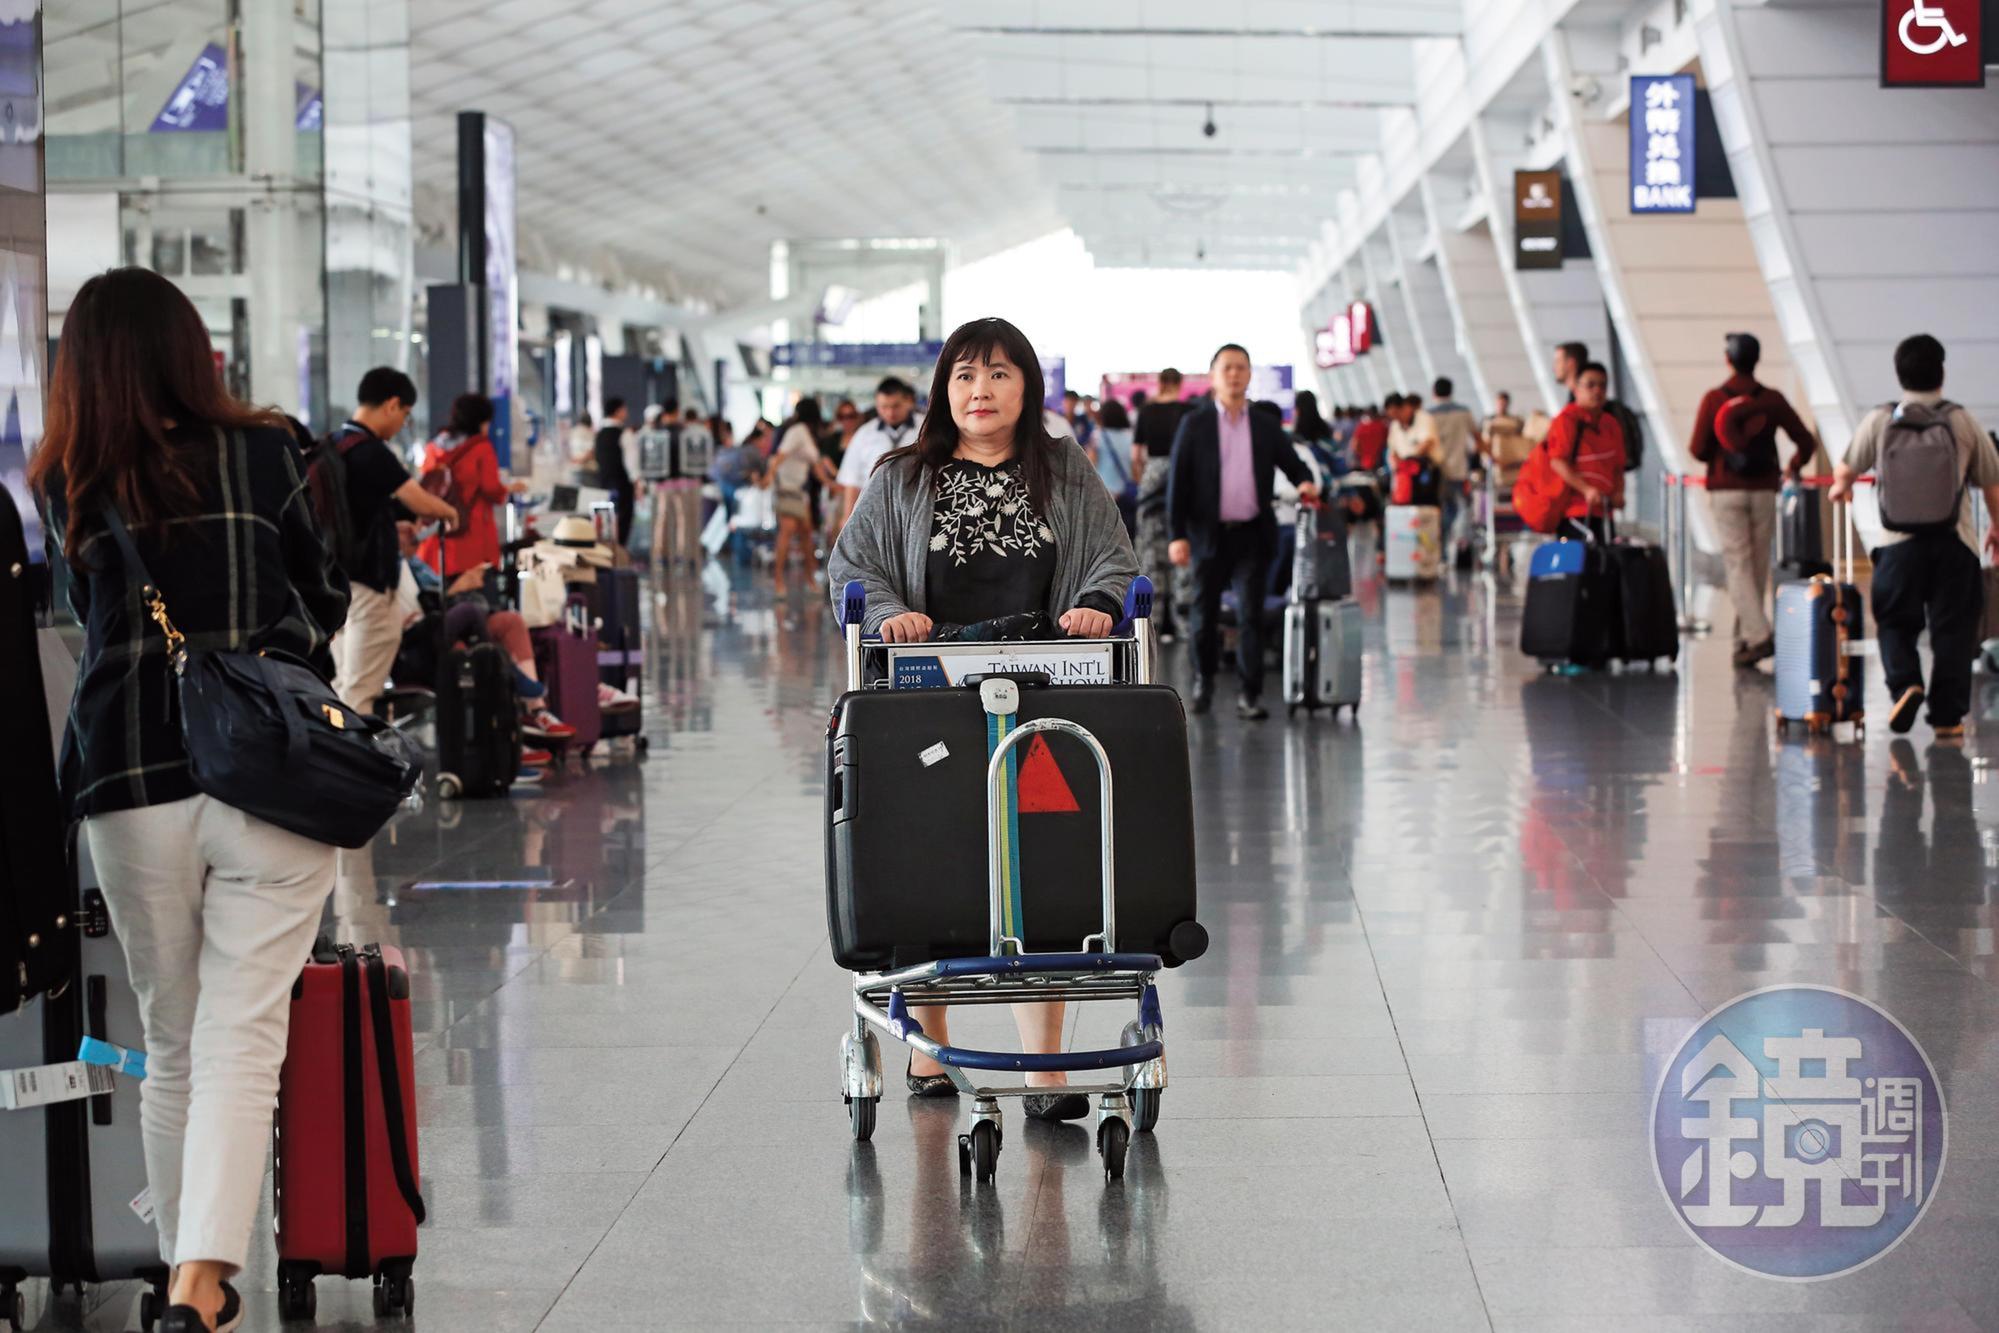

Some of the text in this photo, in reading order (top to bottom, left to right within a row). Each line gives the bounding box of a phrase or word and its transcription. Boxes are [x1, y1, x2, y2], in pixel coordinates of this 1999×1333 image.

[1634, 185, 1692, 208] BANK
[988, 660, 1106, 676] TAIWAN INT'L
[899, 674, 922, 684] 2018
